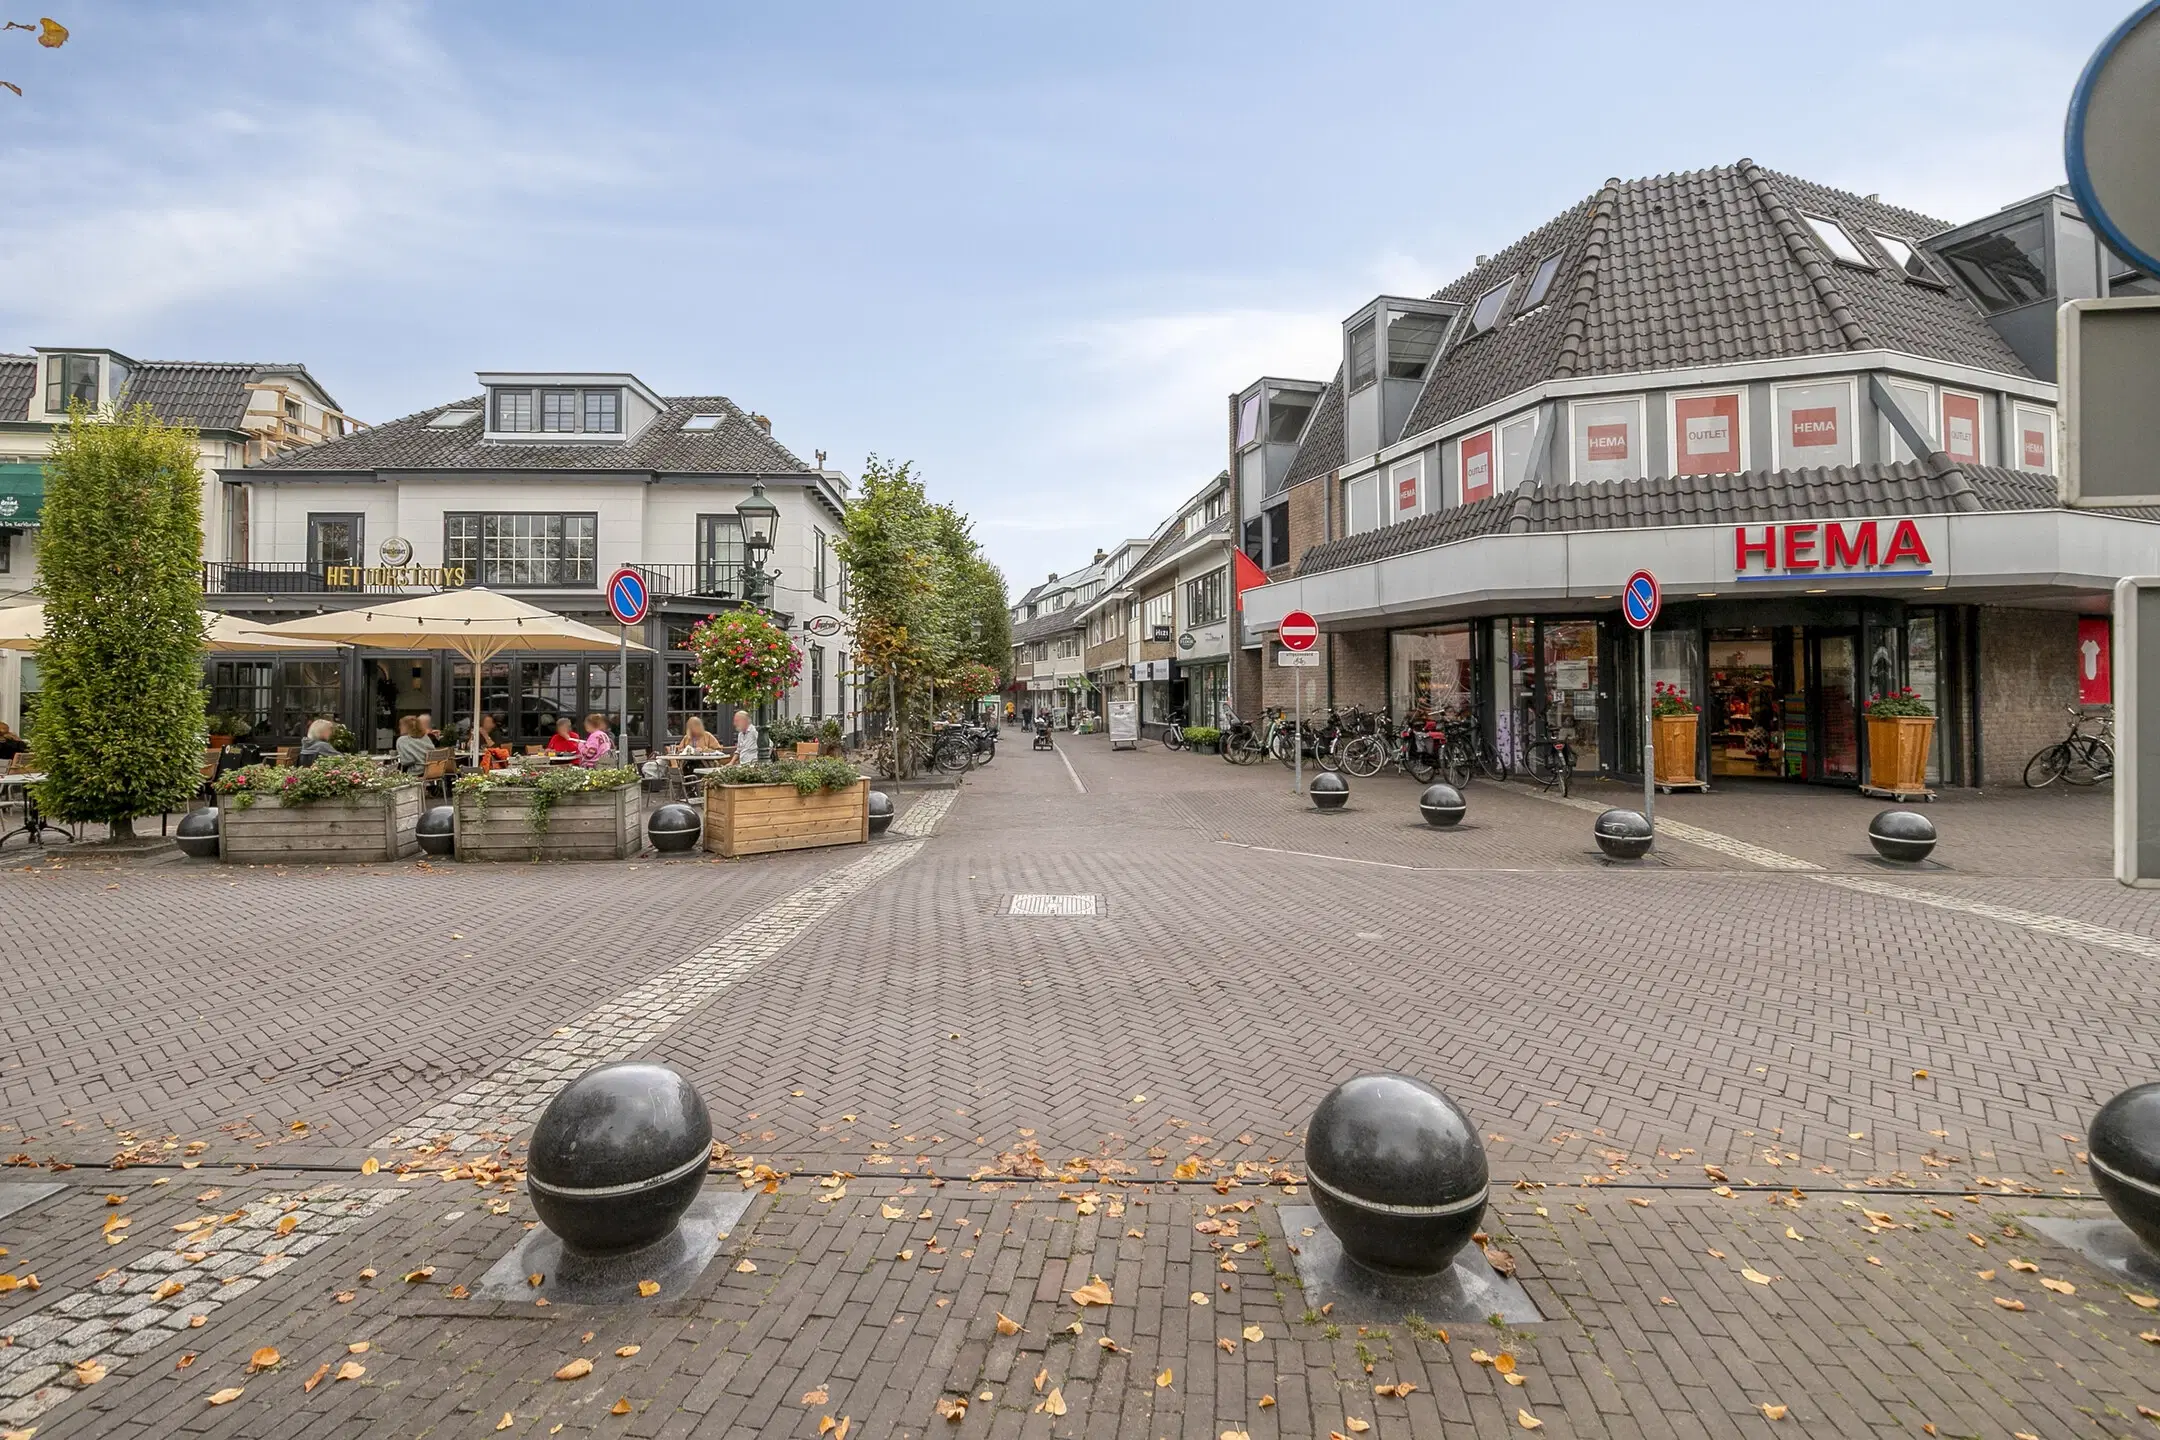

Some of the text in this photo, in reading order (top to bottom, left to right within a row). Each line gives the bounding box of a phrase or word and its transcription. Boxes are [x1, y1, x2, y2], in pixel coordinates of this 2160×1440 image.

[1794, 420, 1835, 433] HEMA
[1688, 429, 1728, 441] OUTLET
[1951, 431, 1972, 442] OUTLET
[1589, 436, 1626, 448] HEMA
[2025, 442, 2044, 455] HEMA
[1468, 463, 1487, 477] OUTLET
[1400, 487, 1416, 500] HEMA
[1735, 519, 1932, 571] HEMA
[327, 565, 362, 586] HET
